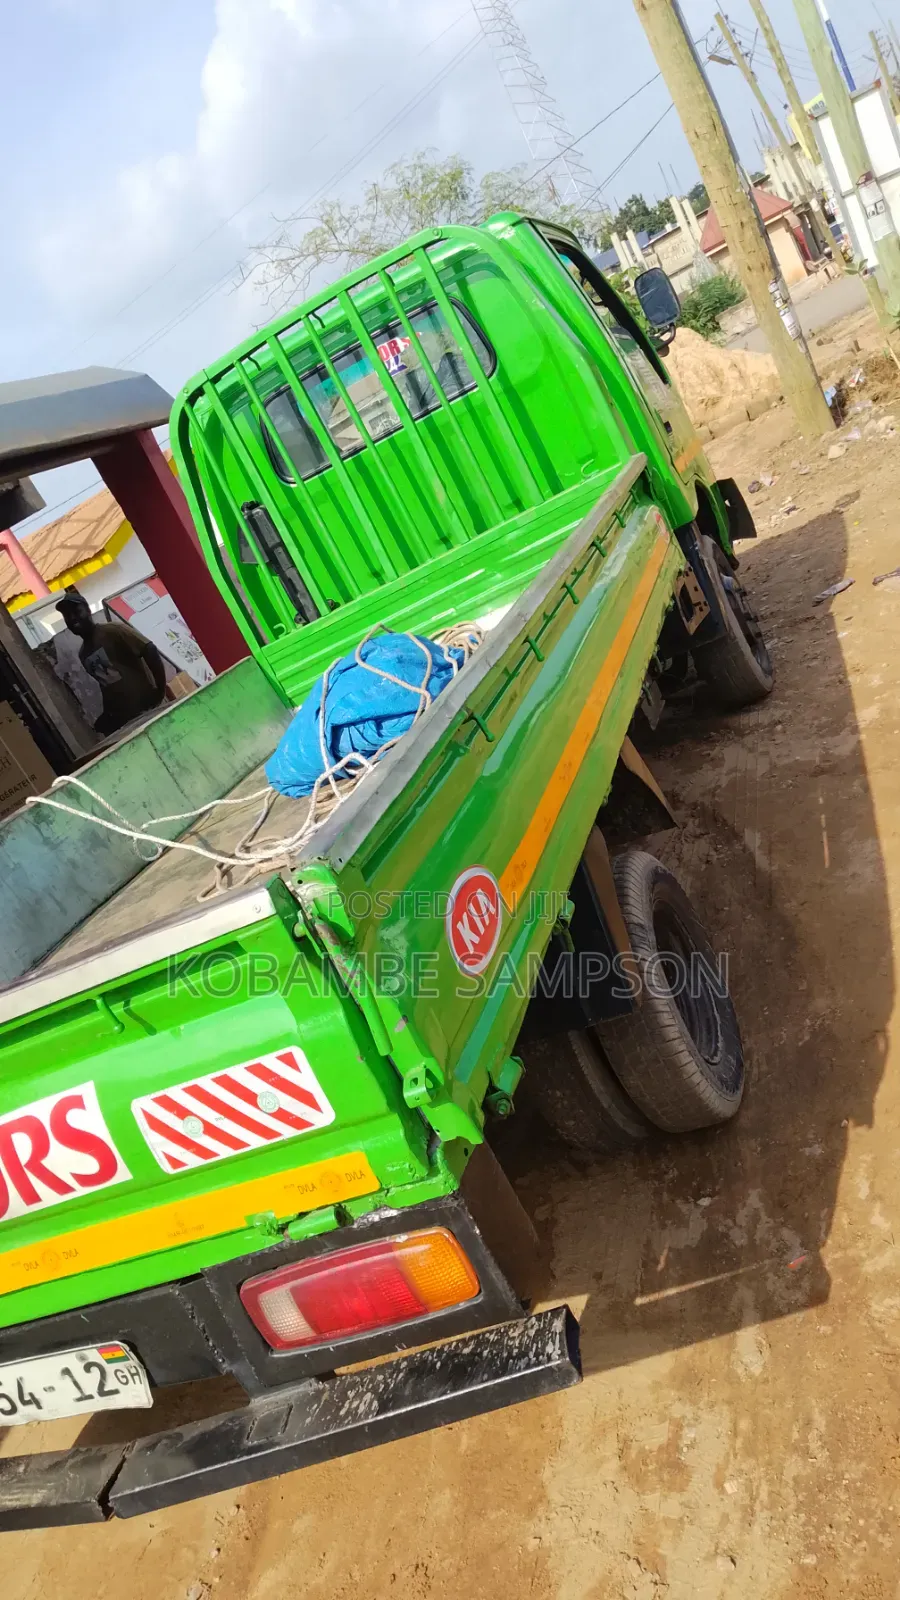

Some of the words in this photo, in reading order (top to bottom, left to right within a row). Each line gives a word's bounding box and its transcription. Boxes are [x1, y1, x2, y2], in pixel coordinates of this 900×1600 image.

[456, 888, 496, 954] KIA
[0, 1094, 118, 1219] RS
[345, 1170, 366, 1182] DVLA
[114, 1365, 143, 1386] GH
